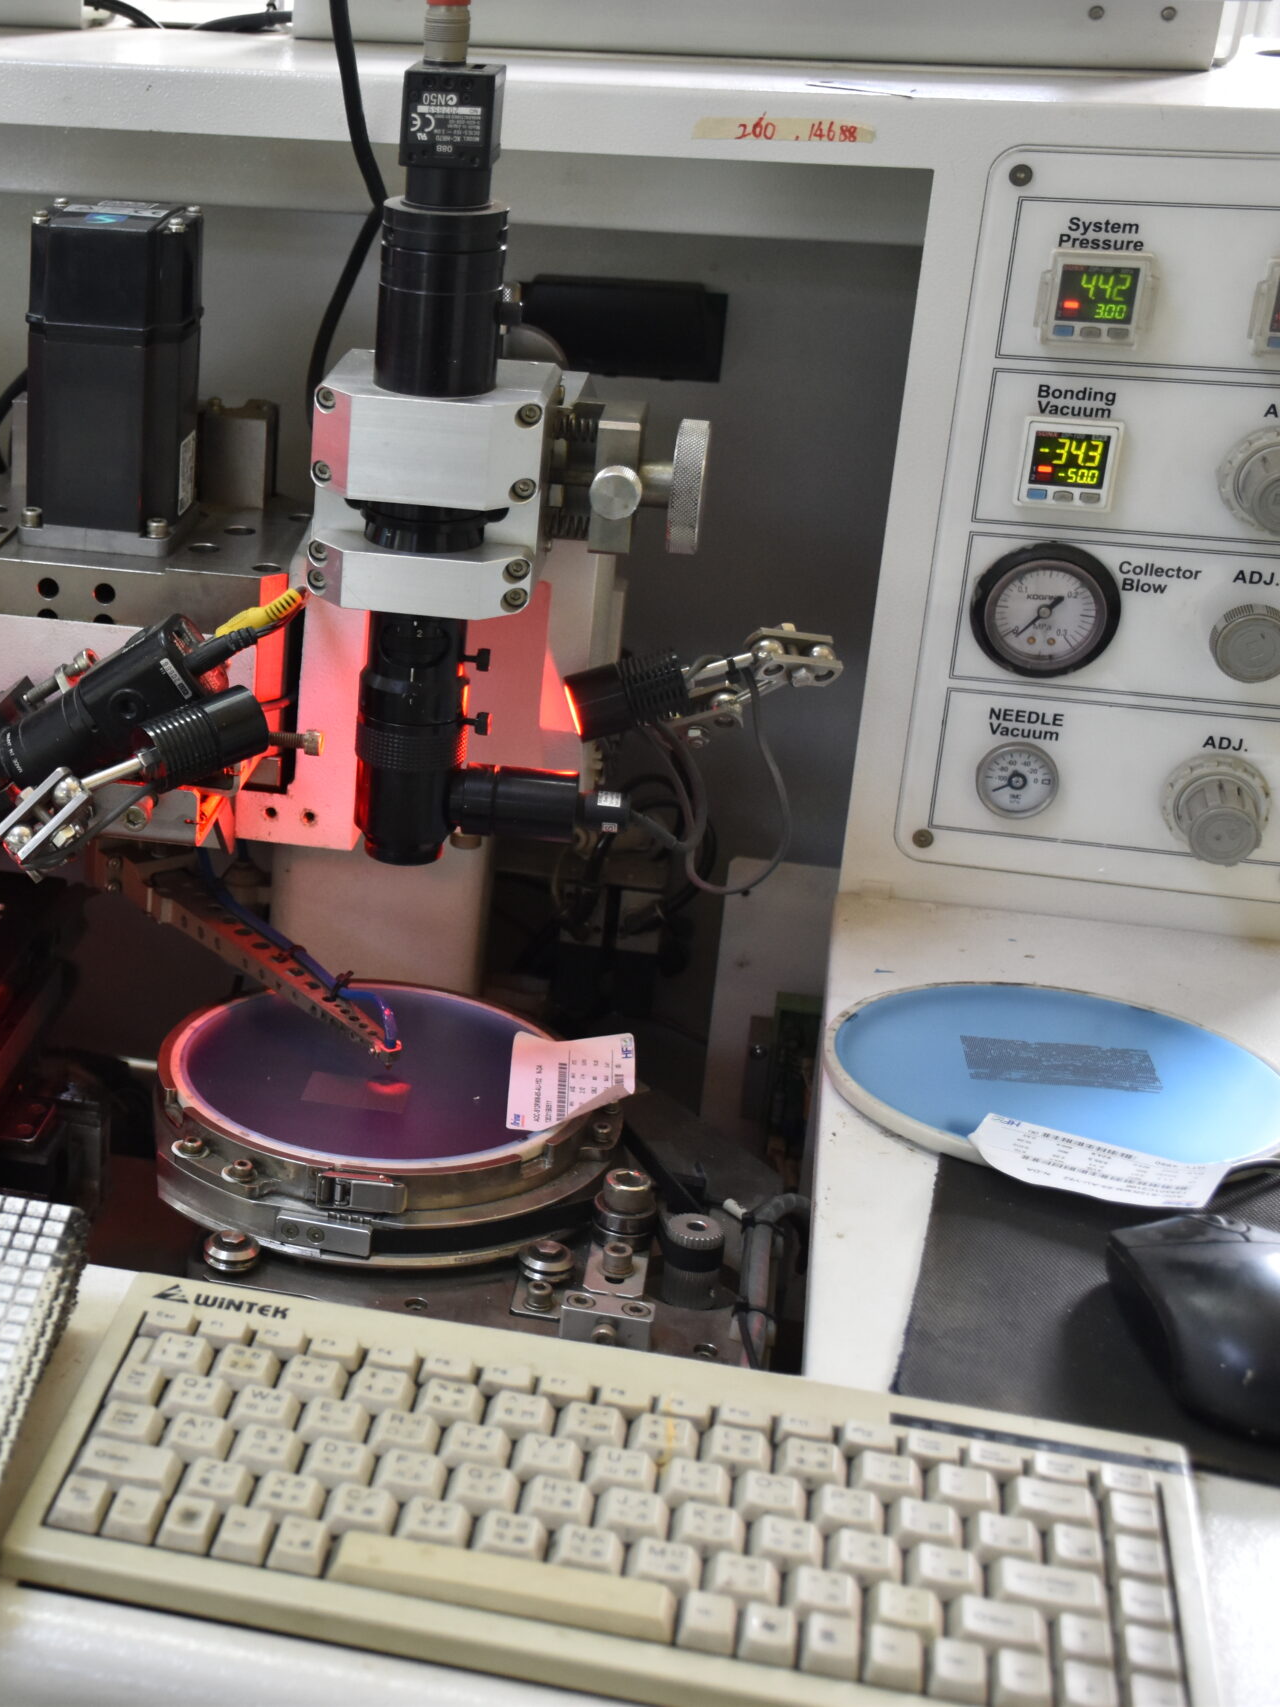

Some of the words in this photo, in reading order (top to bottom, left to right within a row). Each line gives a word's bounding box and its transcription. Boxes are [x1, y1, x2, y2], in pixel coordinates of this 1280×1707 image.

[1068, 216, 1140, 236] System
[1058, 233, 1144, 251] Pressure
[1037, 384, 1117, 406] Bonding
[1038, 400, 1111, 419] Vacuum
[1118, 560, 1202, 580] Collector
[1233, 569, 1280, 587] ADJ.
[1121, 577, 1168, 594] Blow
[989, 707, 1064, 727] NEEDLE
[989, 722, 1060, 741] Vacuum
[1202, 735, 1248, 752] ADJ.
